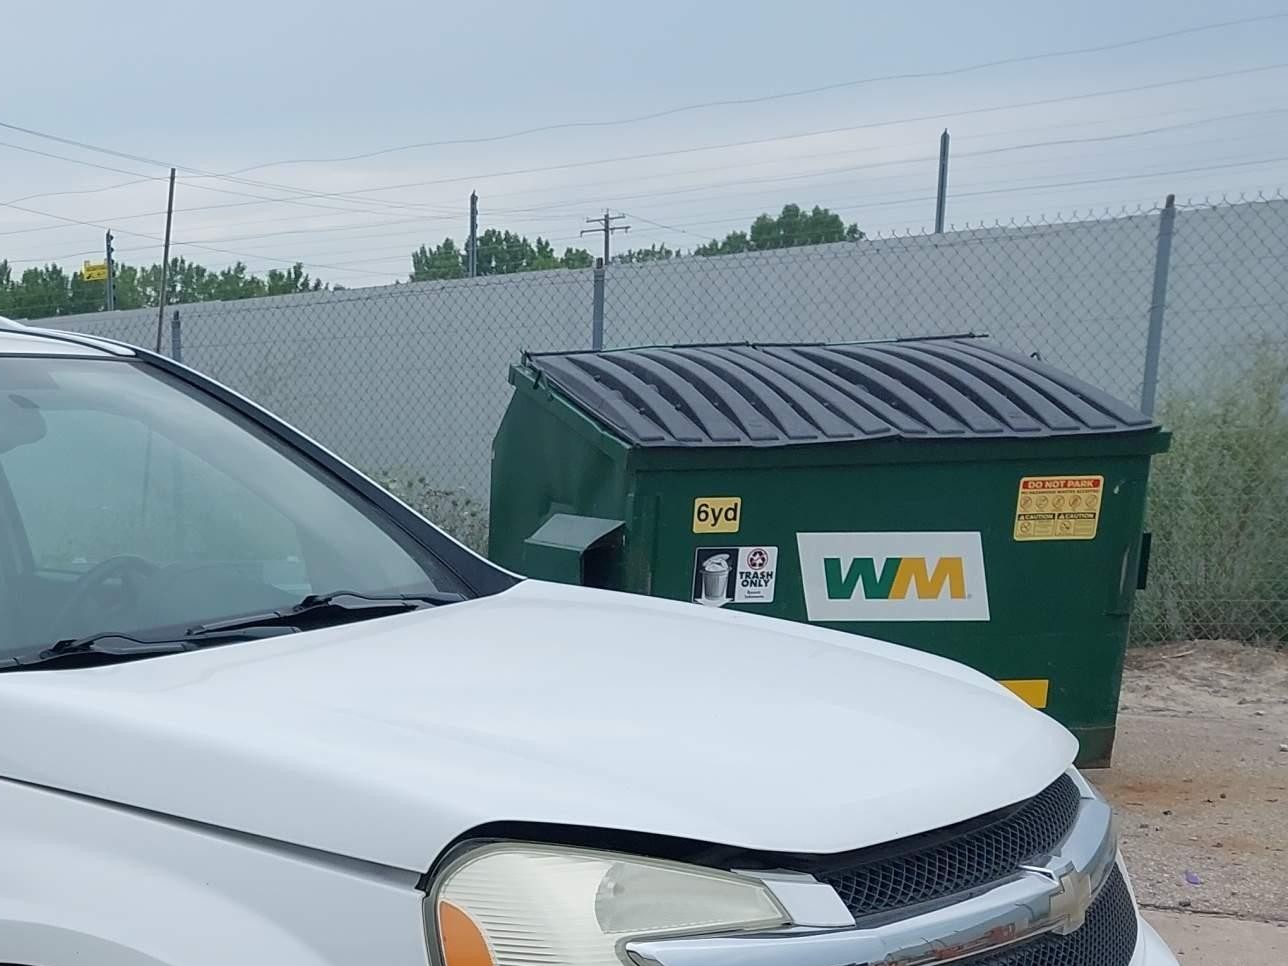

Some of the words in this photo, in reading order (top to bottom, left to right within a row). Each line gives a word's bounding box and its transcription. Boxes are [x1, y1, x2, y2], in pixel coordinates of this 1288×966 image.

[1028, 481, 1043, 489] DO
[1045, 480, 1065, 489] NOT
[1067, 479, 1094, 488] PARK
[697, 502, 738, 527] 6yd
[739, 571, 773, 580] TRASH
[823, 557, 967, 600] WM
[741, 579, 770, 588] ONLY
